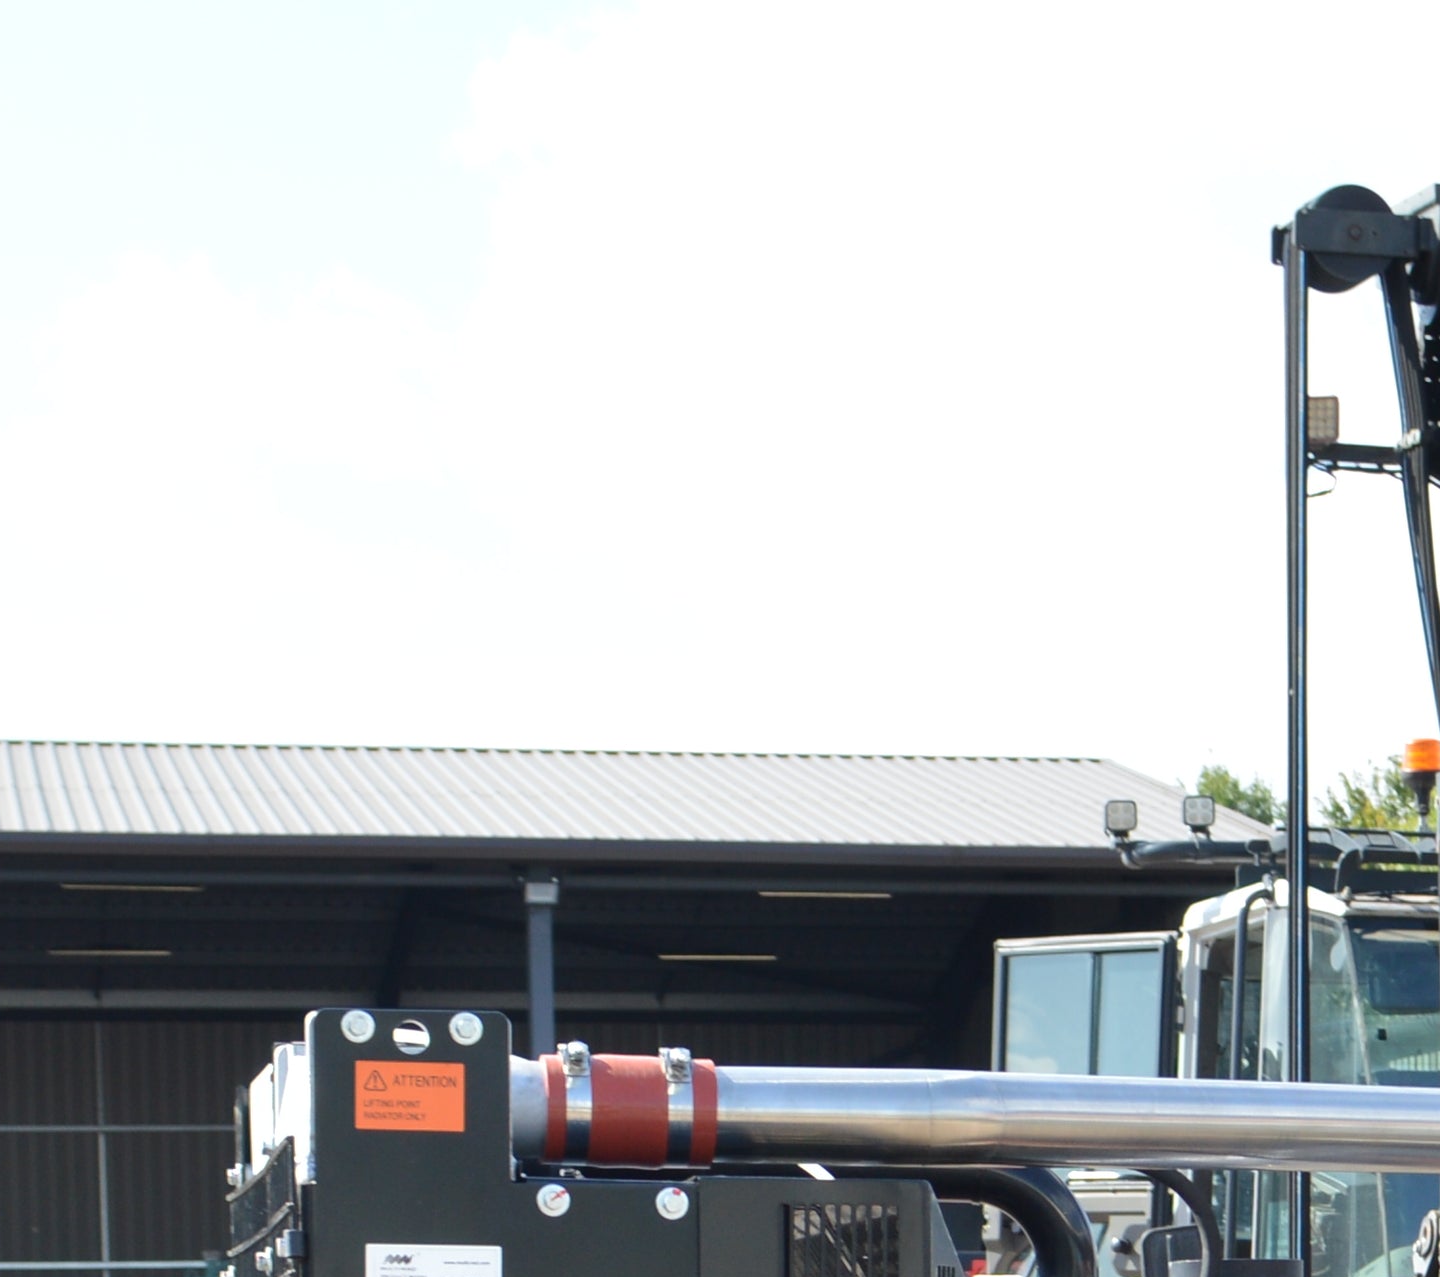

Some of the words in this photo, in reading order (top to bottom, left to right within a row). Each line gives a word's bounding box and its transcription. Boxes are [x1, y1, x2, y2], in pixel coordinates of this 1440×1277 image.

[392, 1074, 457, 1088] ATTENTION
[363, 1099, 393, 1108] LIFTING
[396, 1100, 421, 1108] POINT
[363, 1111, 403, 1120] RADIATOR
